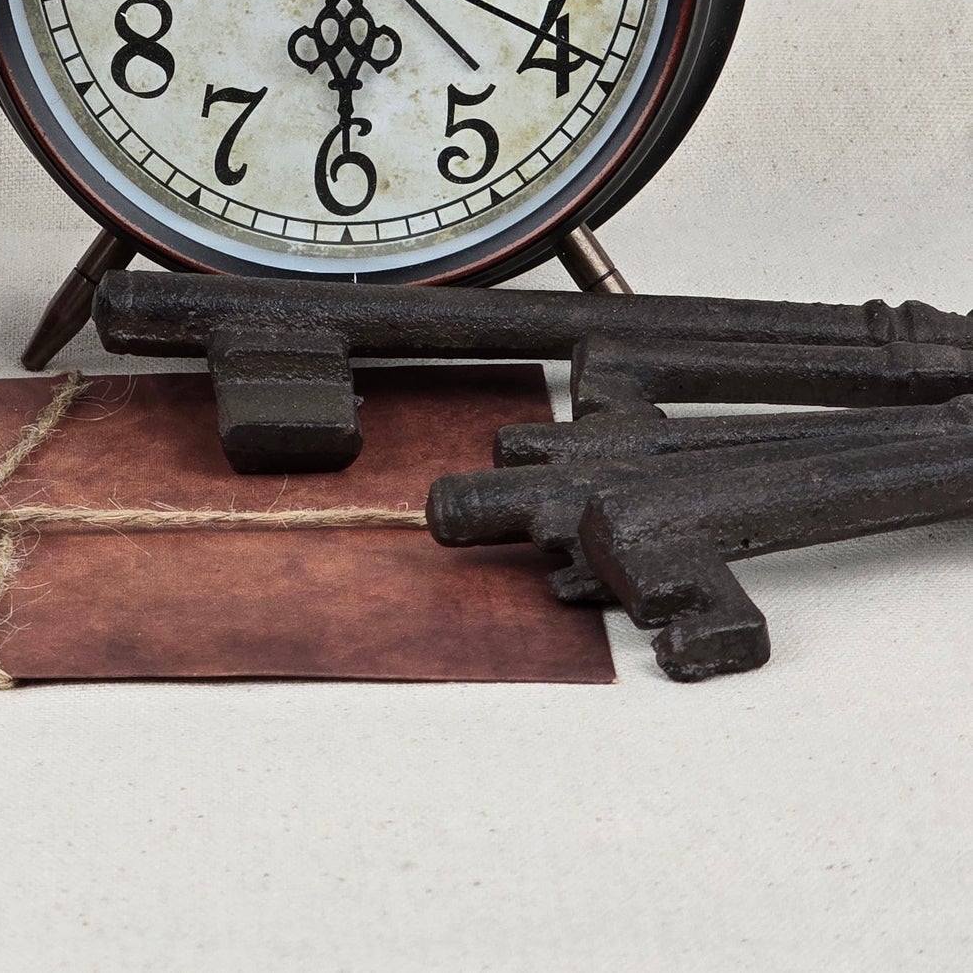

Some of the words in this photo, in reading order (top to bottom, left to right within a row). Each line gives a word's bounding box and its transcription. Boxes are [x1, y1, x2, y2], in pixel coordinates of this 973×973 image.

[201, 84, 268, 186] 7
[314, 116, 377, 216] 6
[437, 83, 499, 184] 5
